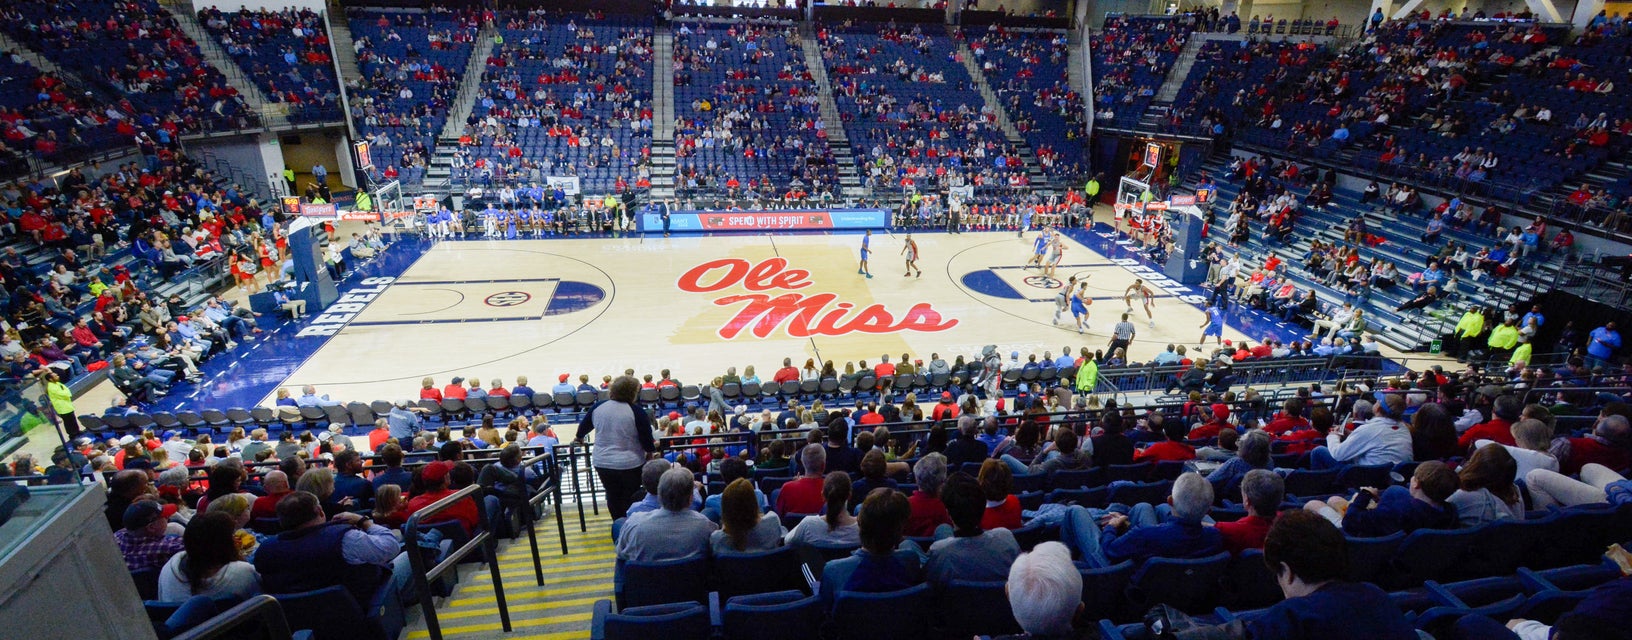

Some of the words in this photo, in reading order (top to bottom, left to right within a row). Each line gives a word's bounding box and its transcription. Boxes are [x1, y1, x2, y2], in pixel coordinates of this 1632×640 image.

[729, 215, 755, 226] SPEND
[756, 216, 777, 225] WITH
[779, 215, 804, 225] SPIRIT
[677, 257, 813, 292] Ole
[1110, 258, 1207, 304] REBELS
[295, 276, 396, 337] REBELS
[713, 293, 959, 339] Miss
